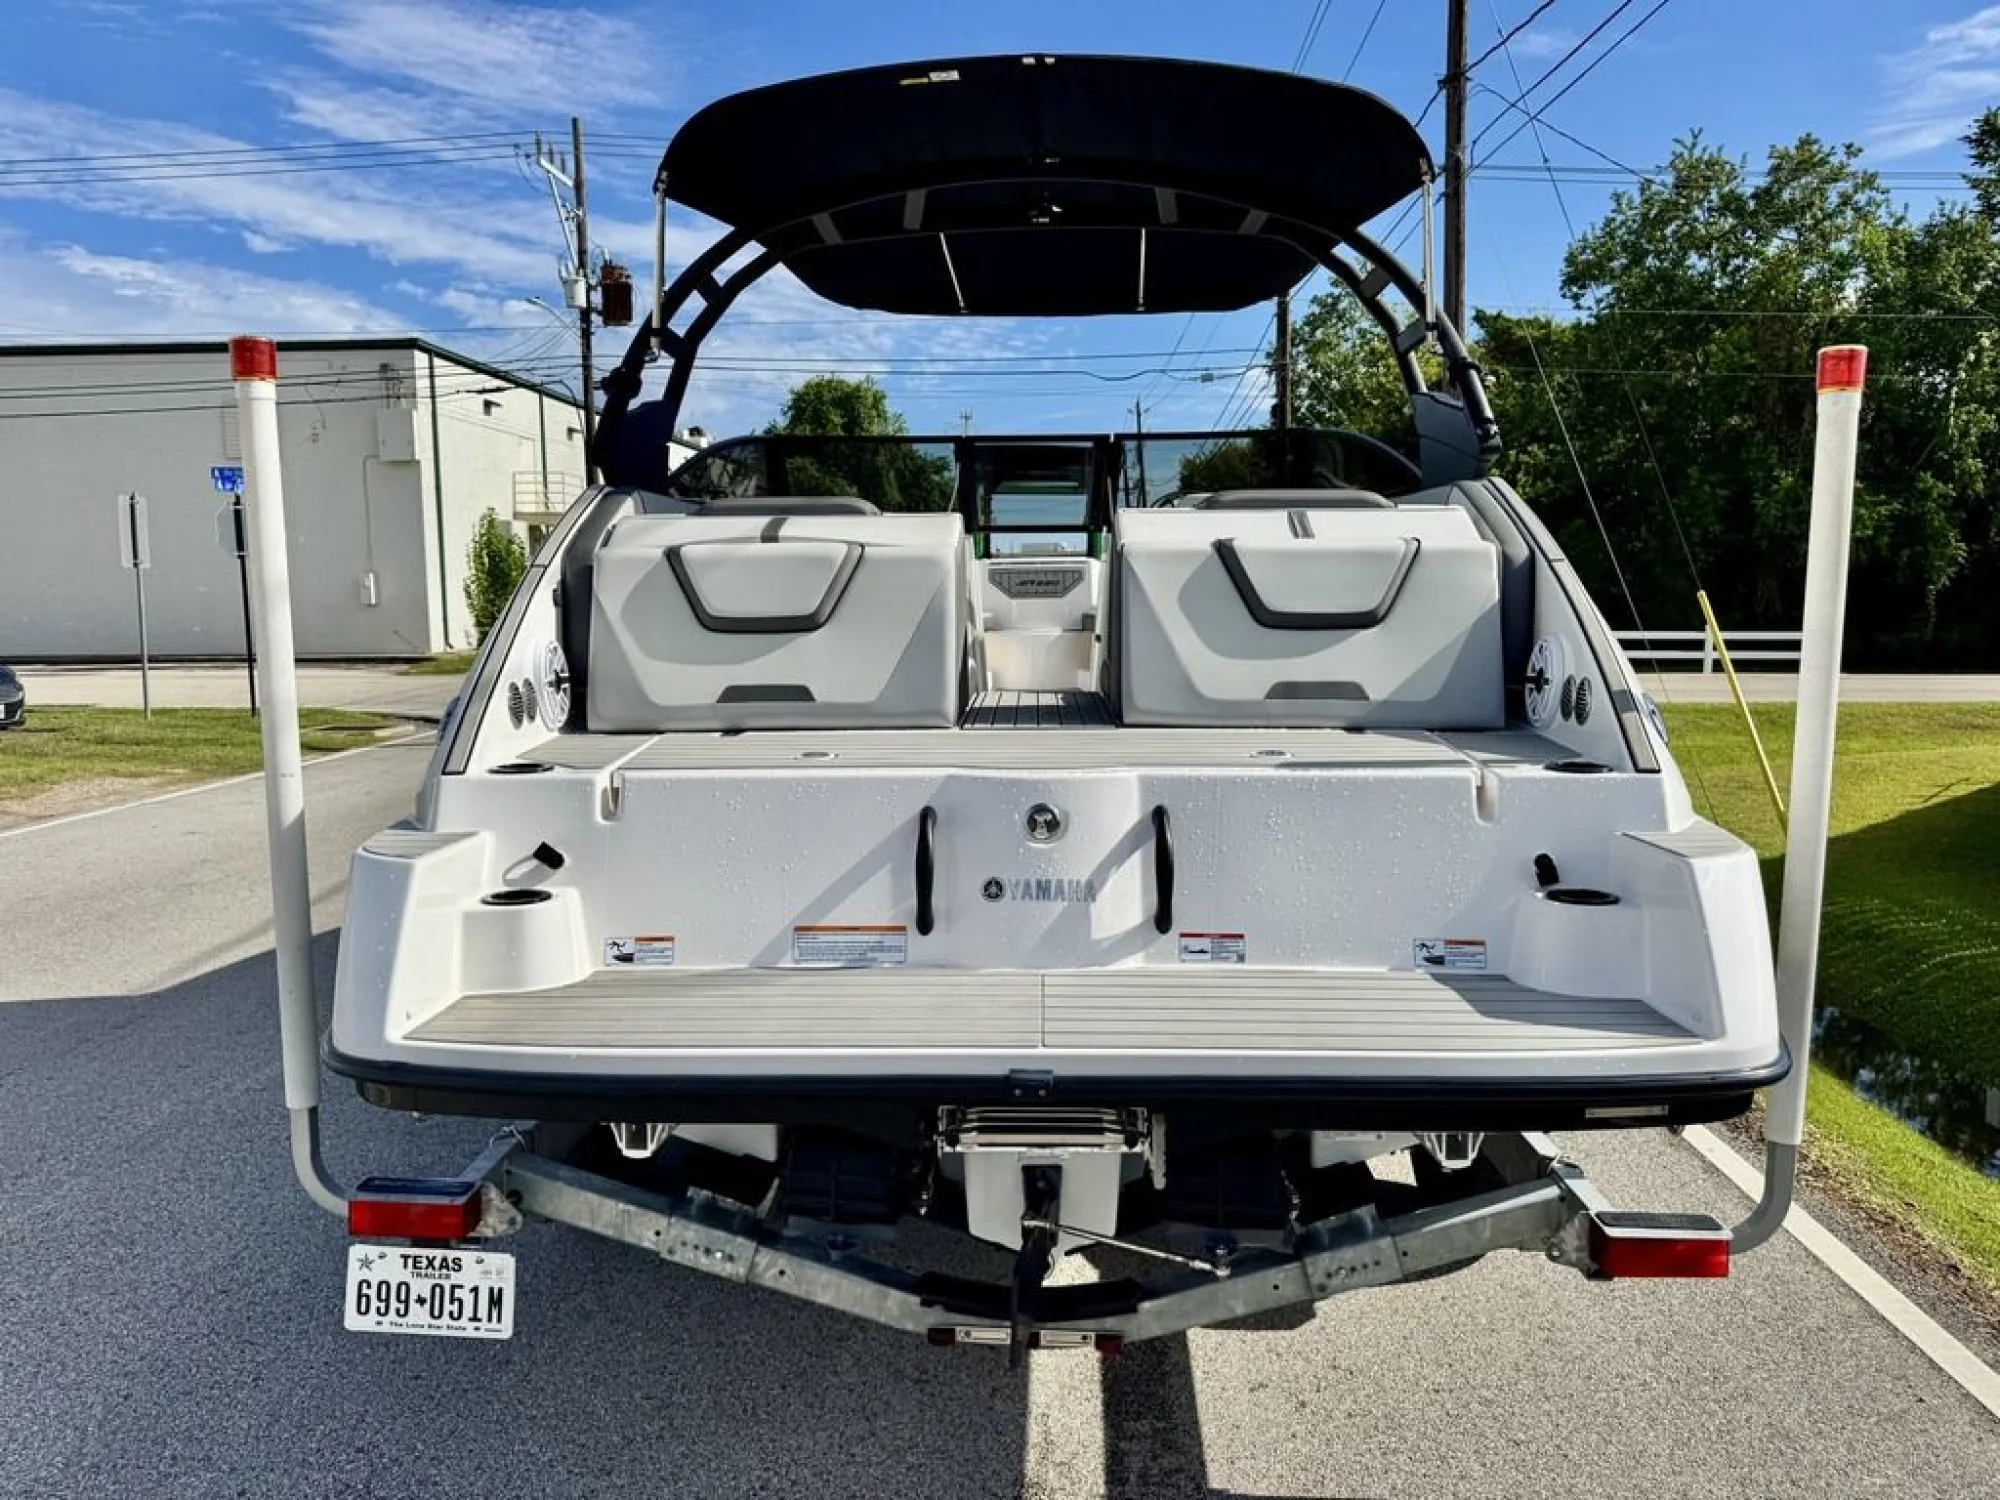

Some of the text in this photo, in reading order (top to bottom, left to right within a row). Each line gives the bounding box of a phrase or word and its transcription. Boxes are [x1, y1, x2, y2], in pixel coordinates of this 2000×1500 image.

[1007, 879, 1097, 902] YAMAHA
[400, 1253, 462, 1272] TEXAS
[410, 1271, 452, 1280] TRAILER
